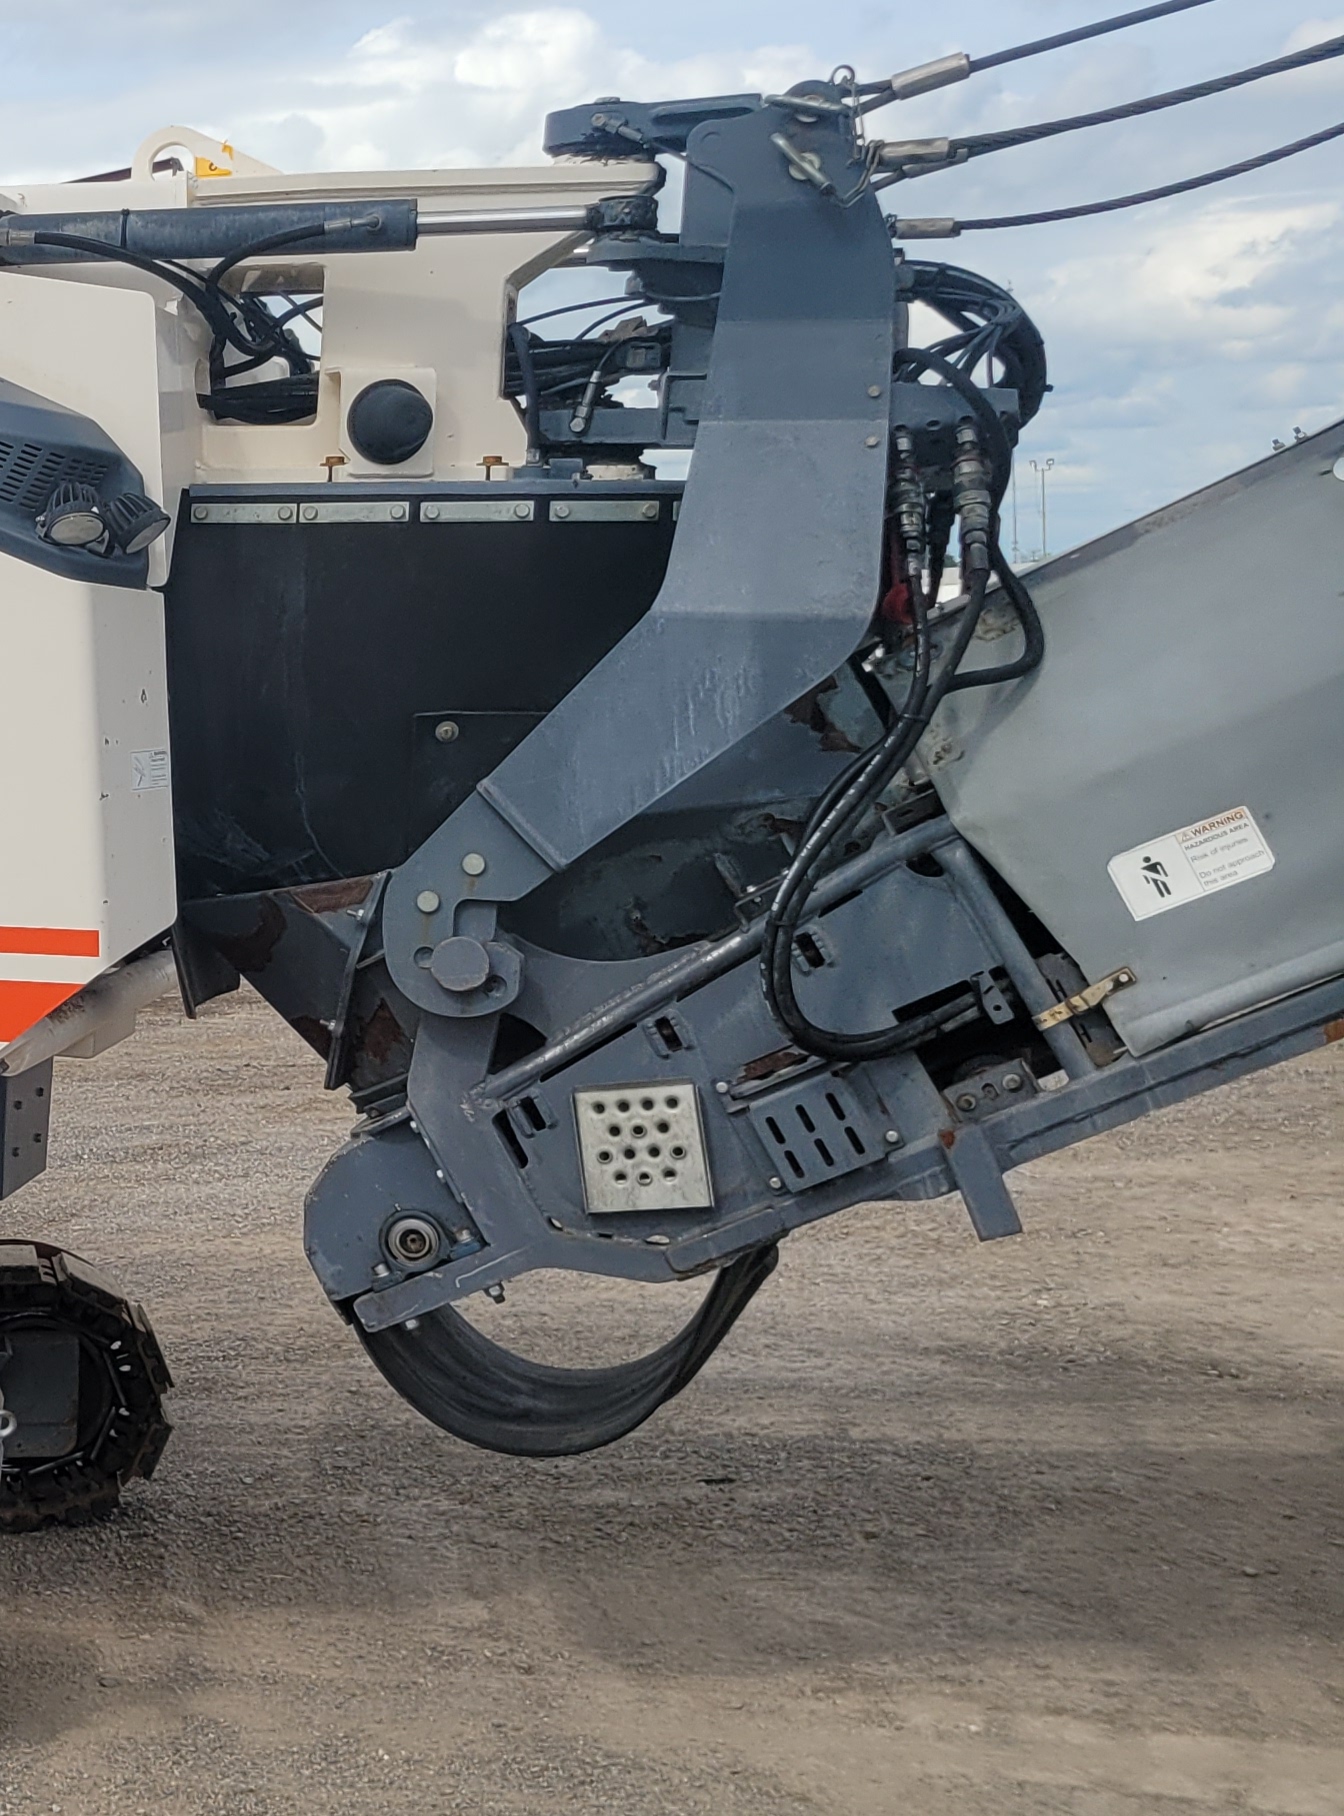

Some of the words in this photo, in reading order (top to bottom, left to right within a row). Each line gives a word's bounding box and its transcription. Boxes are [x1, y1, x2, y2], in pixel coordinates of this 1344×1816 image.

[1184, 830, 1229, 851] HAZARDOUS
[1229, 822, 1249, 834] AREA
[1190, 811, 1244, 837] WARNING
[1190, 852, 1209, 862] Risk
[1210, 847, 1218, 856] of
[1198, 870, 1212, 879] Do
[1213, 864, 1226, 874] not
[1228, 849, 1265, 868] approach
[1220, 870, 1239, 881] area
